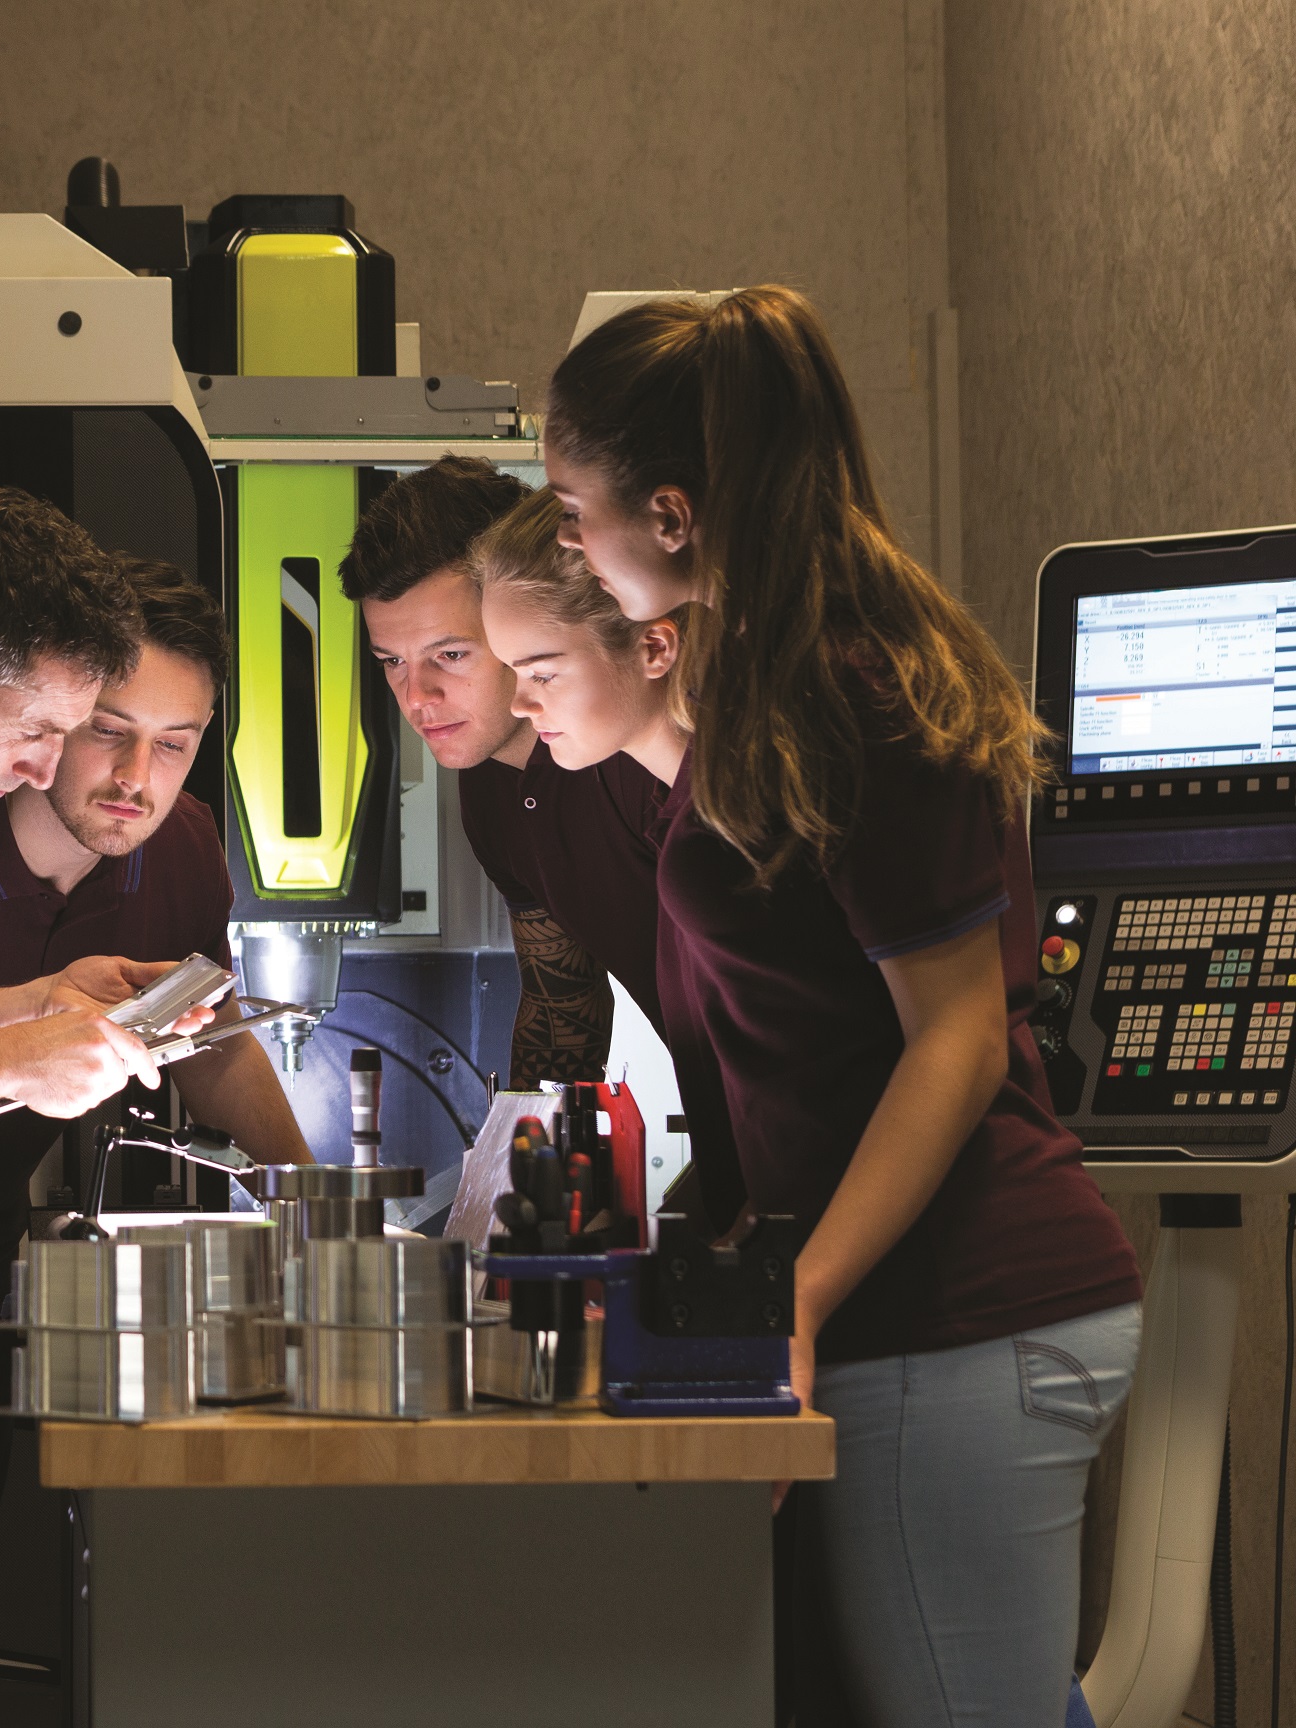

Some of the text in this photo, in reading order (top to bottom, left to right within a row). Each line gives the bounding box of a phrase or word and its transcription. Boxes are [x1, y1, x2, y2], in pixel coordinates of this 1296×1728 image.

[1084, 635, 1090, 644] X
[1084, 646, 1090, 654] Y
[1083, 657, 1089, 666] Z
